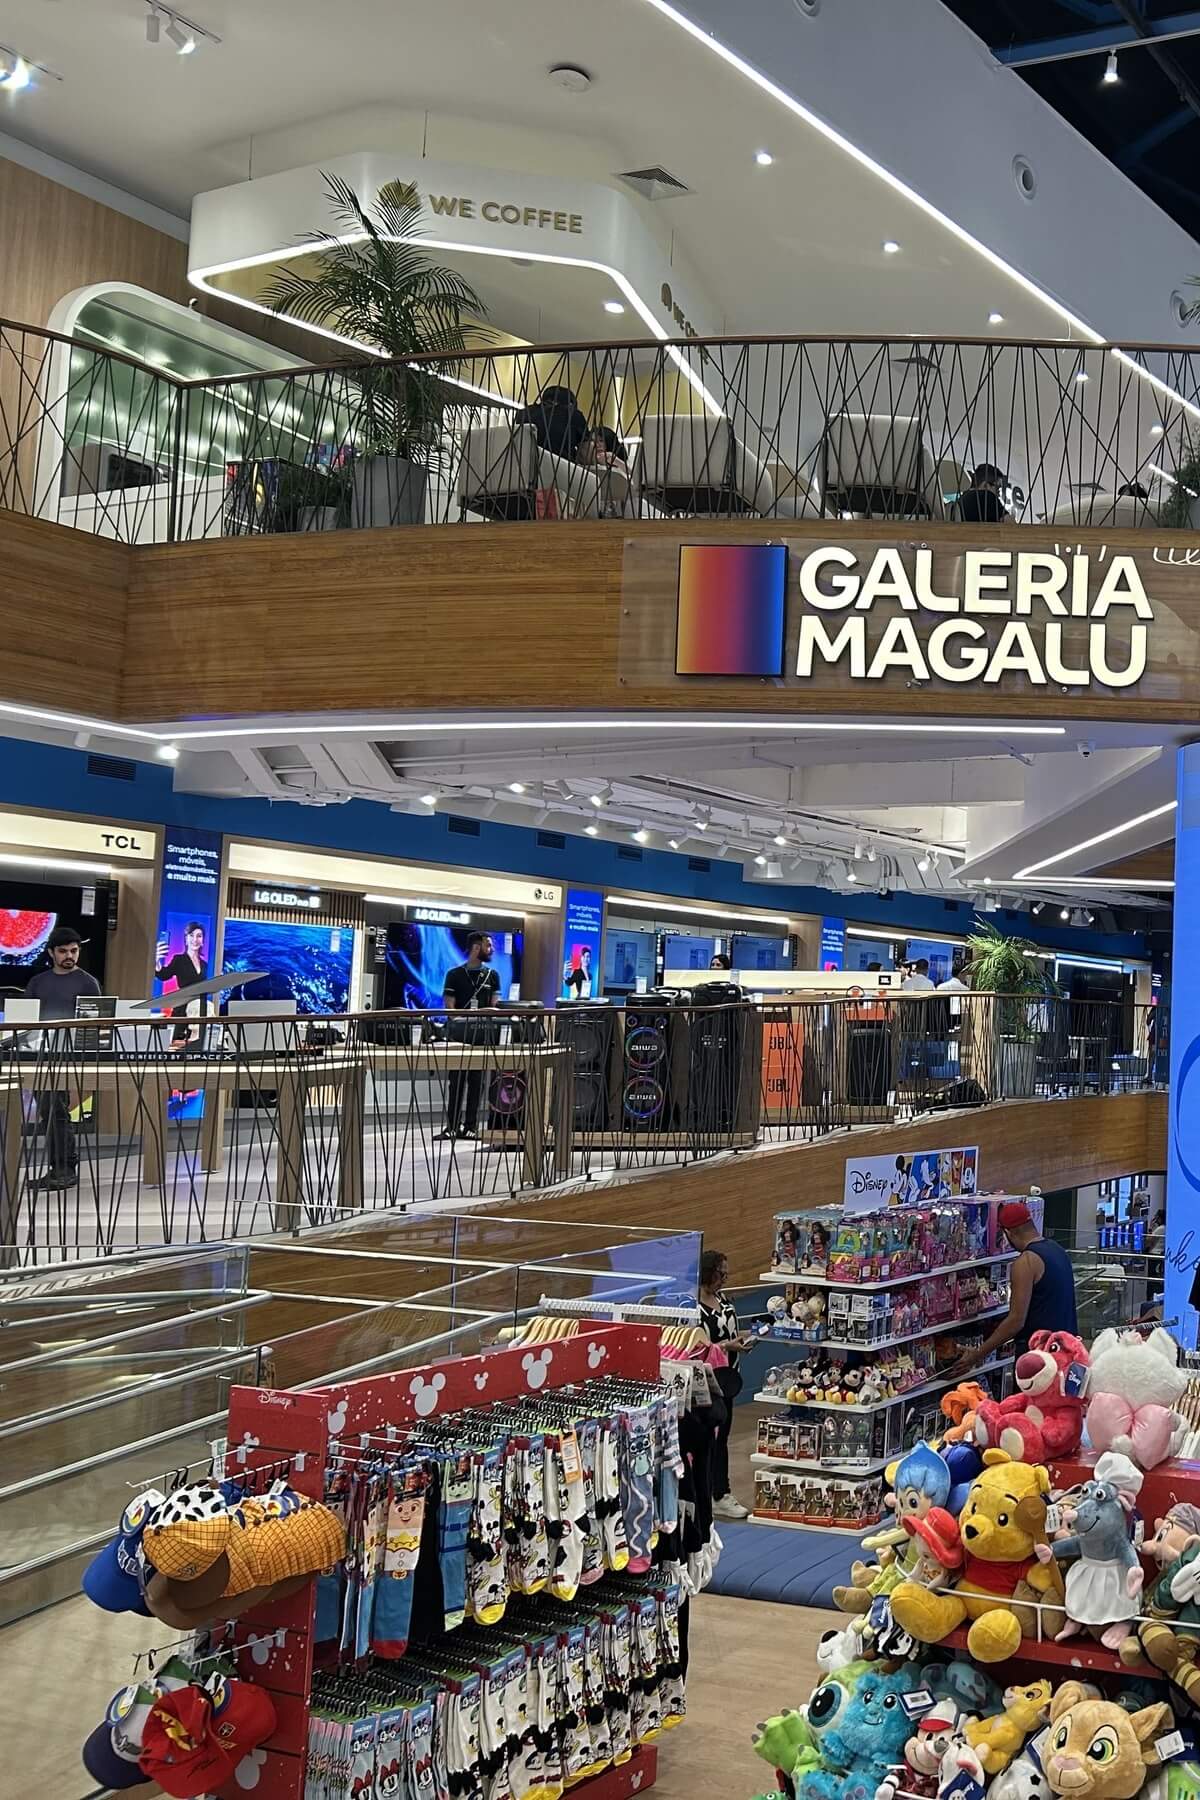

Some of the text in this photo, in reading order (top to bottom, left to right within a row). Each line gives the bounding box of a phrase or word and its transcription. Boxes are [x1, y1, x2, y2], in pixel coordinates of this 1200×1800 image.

[428, 194, 583, 234] WE COFFEE
[798, 546, 1154, 619] GALERIA
[796, 615, 1148, 687] MAGALU
[101, 834, 141, 850] TCL
[167, 844, 219, 859] Smartphones,
[173, 873, 197, 882] muito
[197, 875, 216, 884] mais
[255, 890, 270, 903] LG
[270, 892, 297, 906] OLED
[544, 891, 554, 901] LG
[769, 1036, 792, 1050] JBL
[767, 1079, 791, 1092] JBL
[850, 1170, 888, 1198] Disney
